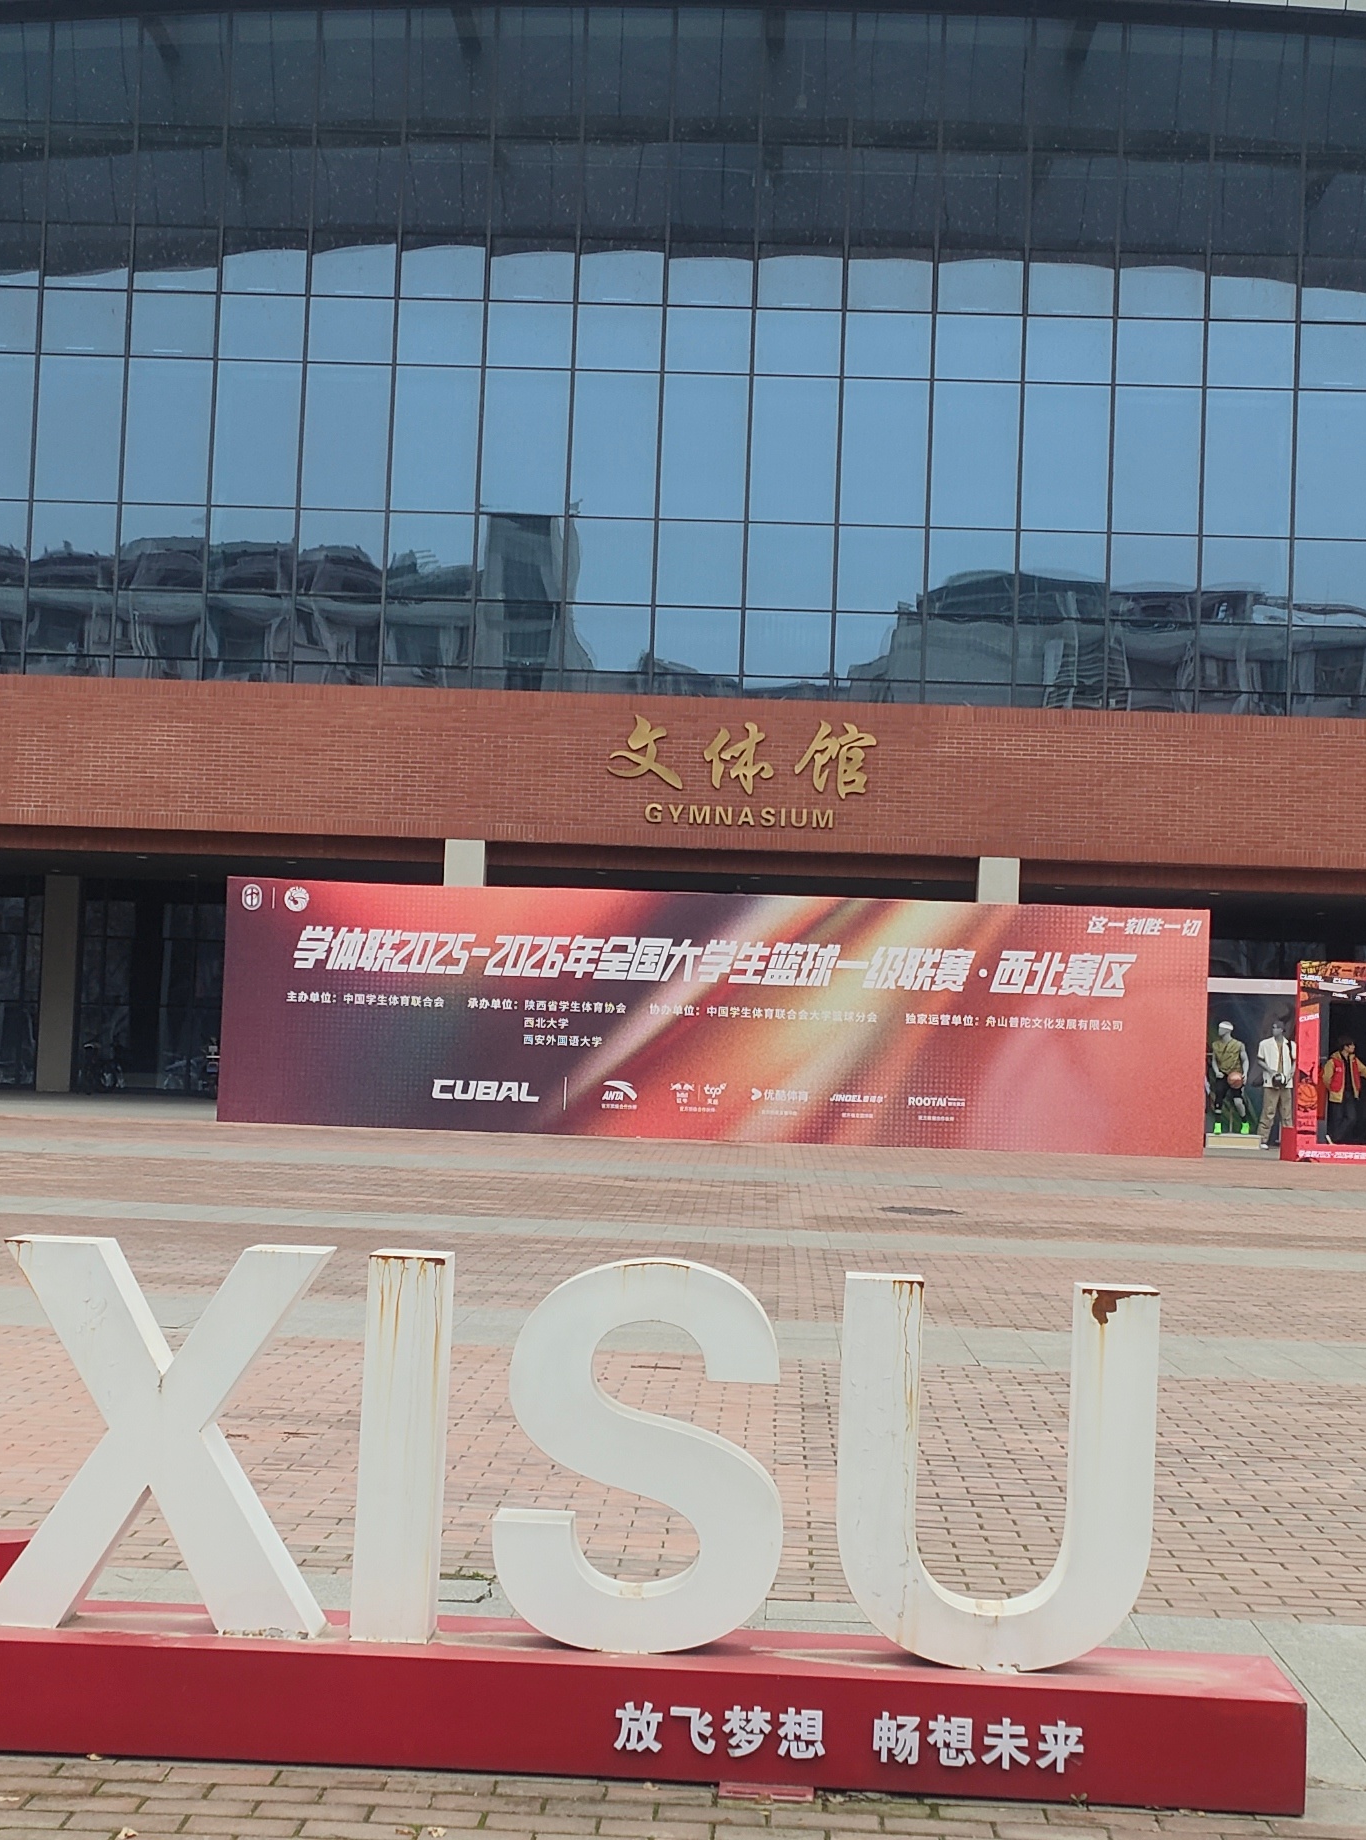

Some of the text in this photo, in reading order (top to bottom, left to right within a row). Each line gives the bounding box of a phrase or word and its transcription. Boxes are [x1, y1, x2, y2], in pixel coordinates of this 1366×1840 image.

[607, 714, 877, 800] 文体馆
[644, 802, 834, 829] GYMNASIUM
[1086, 915, 1203, 937] 这一刻胜一切
[292, 925, 1137, 999] 学体联2025-2026年全国大学生篮球一级联赛·西北赛区
[523, 1016, 569, 1029] 西北大学
[523, 1034, 603, 1048] 西安外国语大学
[432, 1079, 540, 1103] CUBAL
[602, 1090, 624, 1101] ANTA
[763, 1089, 809, 1102] 优酷体育
[613, 1700, 1085, 1774] 放飞梦想 畅想未来
